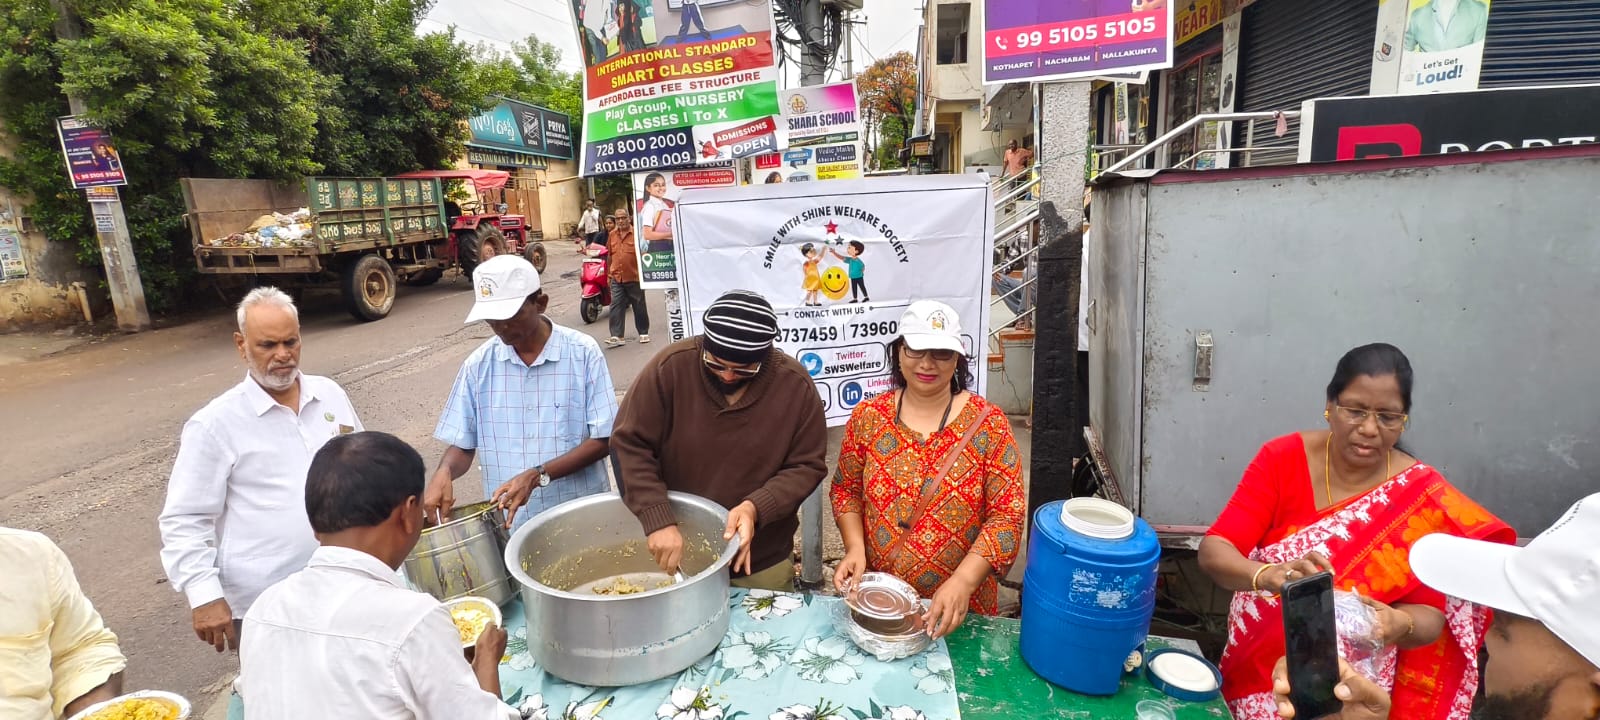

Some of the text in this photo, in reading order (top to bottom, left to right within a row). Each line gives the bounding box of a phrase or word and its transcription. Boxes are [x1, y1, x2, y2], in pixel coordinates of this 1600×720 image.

[1016, 16, 1156, 48] 99 5105 5105
[596, 36, 757, 78] INTERNATIONAL STANDARD
[992, 60, 1034, 72] KOTHAPET
[1102, 47, 1158, 60] NALLAKUNTA
[1423, 58, 1458, 70] Let's Get
[611, 56, 734, 89] SMART CLASSES
[1416, 64, 1464, 86] Loud!
[598, 71, 761, 108] AFFORDABLE FEE STRUCTURE
[605, 88, 746, 122] Play Group, NURSERY
[547, 120, 567, 134] PRIYA
[616, 113, 679, 134] CLASSES
[693, 111, 712, 122] To
[717, 107, 728, 119] X
[787, 110, 856, 130] SHARA SCHOOL
[716, 122, 768, 143] ADMISSIONS
[596, 132, 687, 158] 728 800 2000
[733, 138, 770, 155] OPEN
[470, 152, 510, 164] RESTAURANT
[595, 160, 627, 174] 8019
[630, 155, 659, 169] 008
[662, 151, 690, 166] 009
[763, 205, 910, 270] SMILE WITH SHINE WELFARE SOCIETY
[794, 306, 865, 319] CONTACT WITH US
[670, 308, 684, 342] 57806
[850, 320, 899, 338] 73960
[836, 350, 867, 361] Twitter:
[824, 361, 882, 375] SWSWelfare
